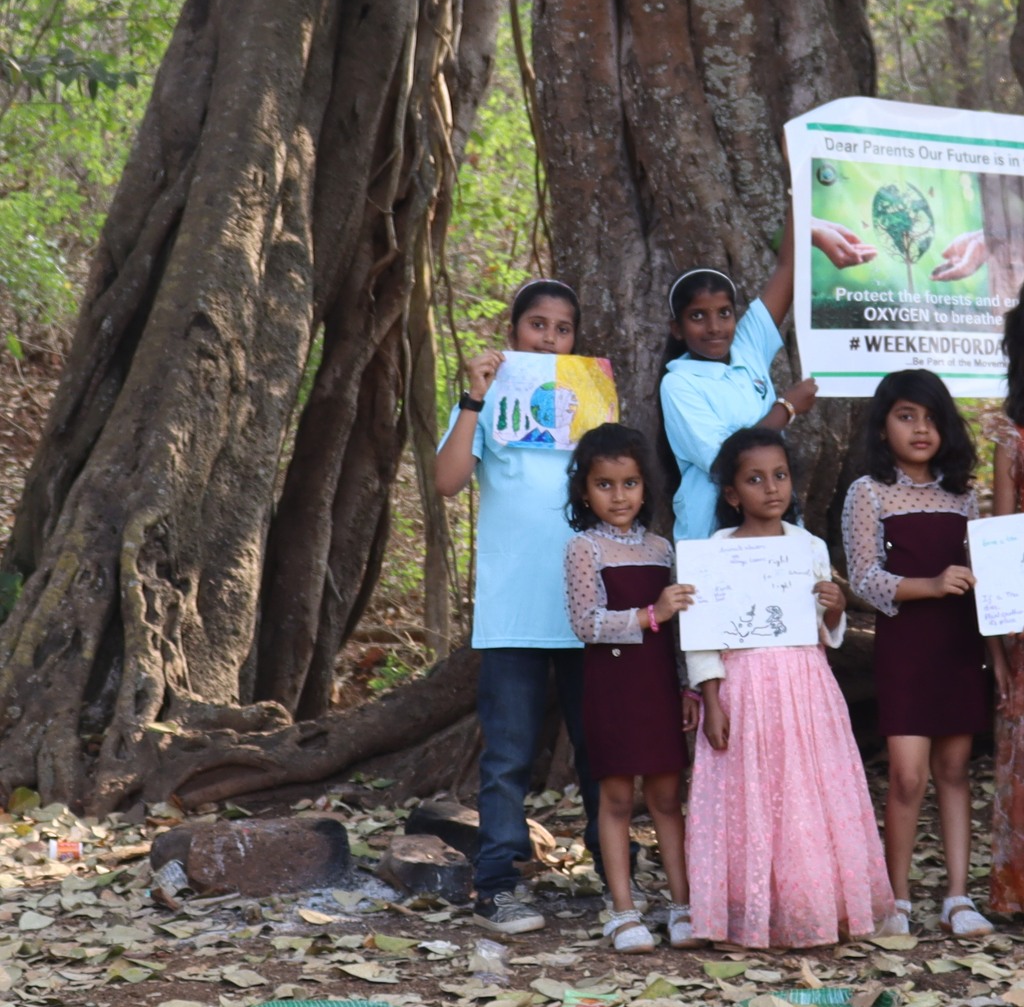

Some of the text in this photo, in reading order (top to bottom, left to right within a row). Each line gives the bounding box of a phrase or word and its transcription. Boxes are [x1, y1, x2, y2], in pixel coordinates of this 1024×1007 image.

[824, 137, 858, 153] Dear
[863, 140, 915, 159] Parents
[918, 146, 942, 161] Our
[946, 148, 990, 165] Future
[994, 153, 1005, 167] is
[1009, 153, 1019, 167] in
[835, 287, 1019, 308] Protect the forests and en
[864, 307, 1003, 326] OXYGEN to breathe
[864, 335, 1004, 356] WEEKENDFORDA
[927, 357, 944, 367] Part
[958, 358, 972, 367] the
